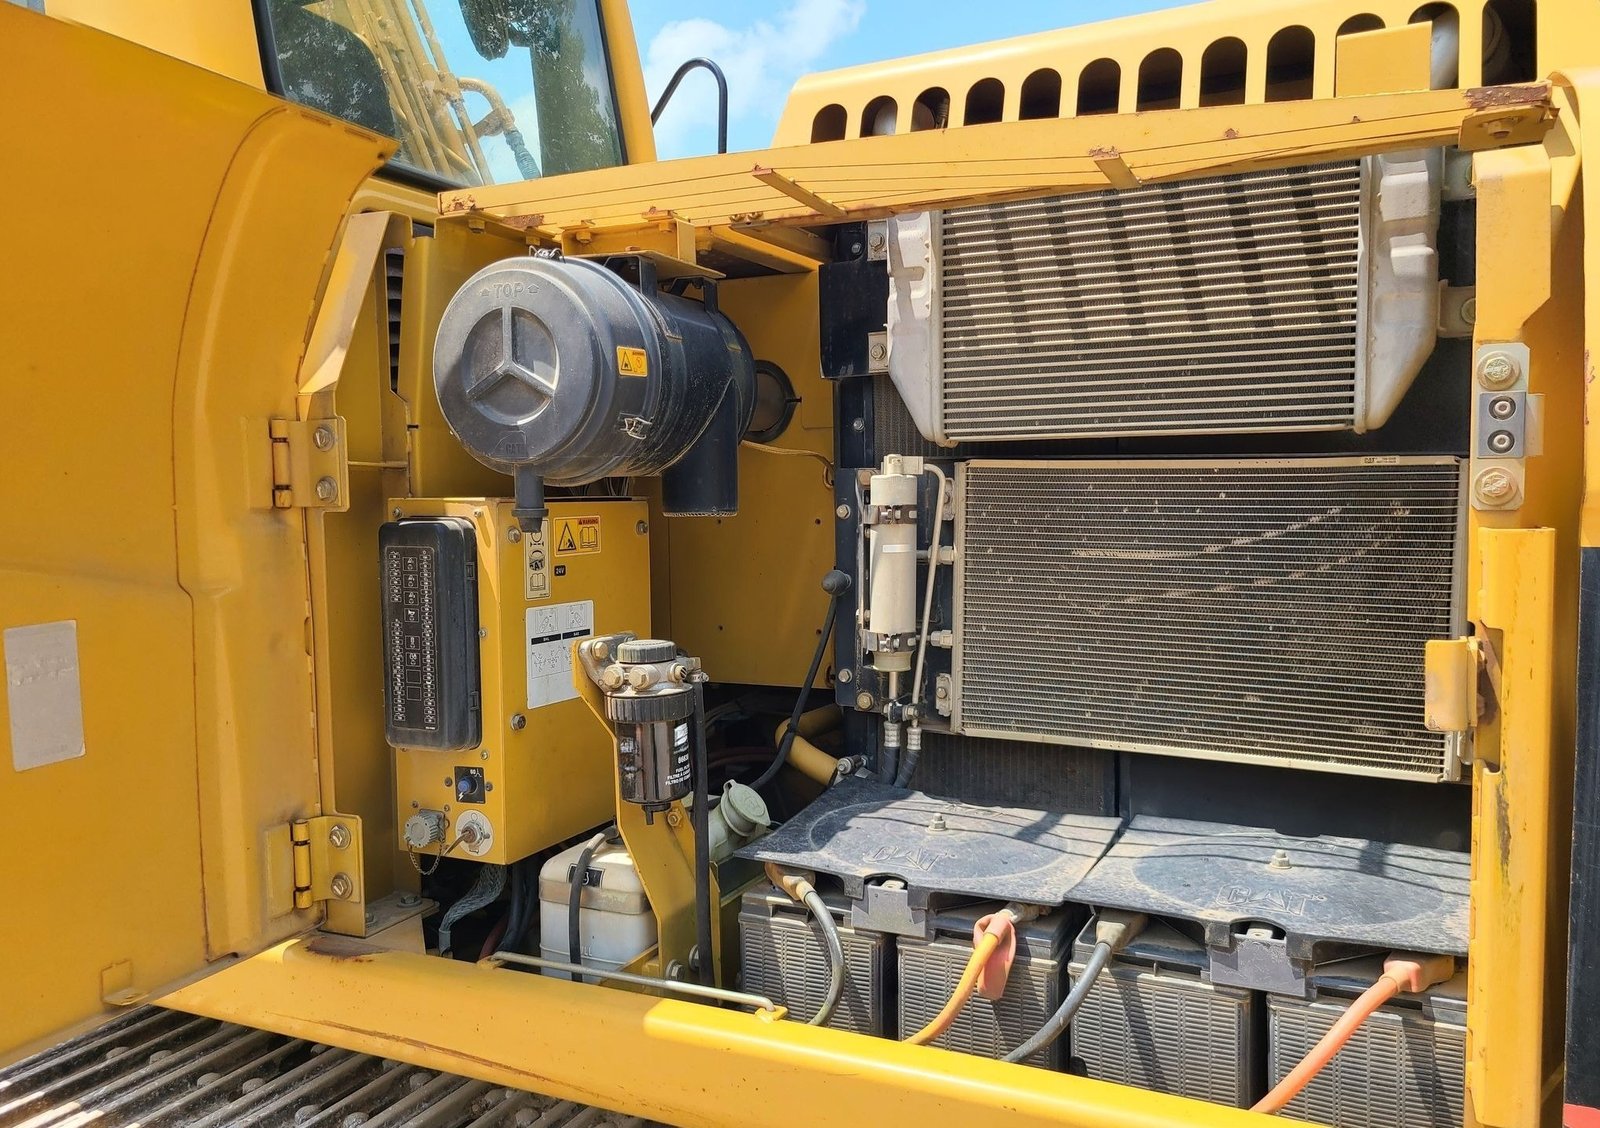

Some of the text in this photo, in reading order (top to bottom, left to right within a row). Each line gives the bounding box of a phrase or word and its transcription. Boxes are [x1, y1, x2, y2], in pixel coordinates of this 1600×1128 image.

[493, 282, 524, 299] TOP
[863, 846, 940, 872] CAT
[1216, 884, 1307, 916] CAT
